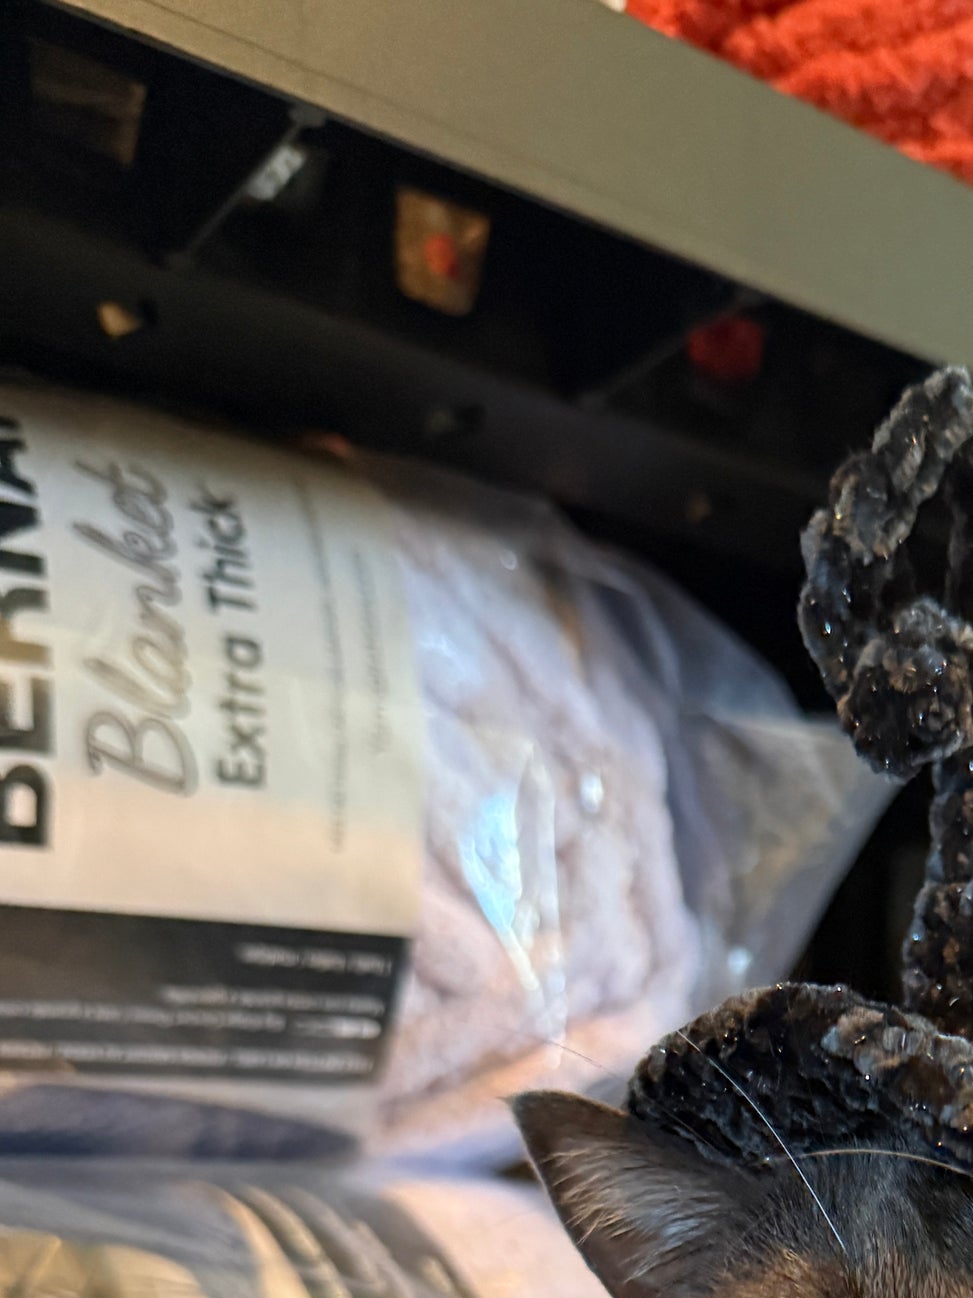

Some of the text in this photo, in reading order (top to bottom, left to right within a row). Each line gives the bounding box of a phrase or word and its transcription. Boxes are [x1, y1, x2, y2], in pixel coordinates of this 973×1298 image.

[73, 459, 198, 796] Blanket
[191, 485, 265, 788] Extra Thick
